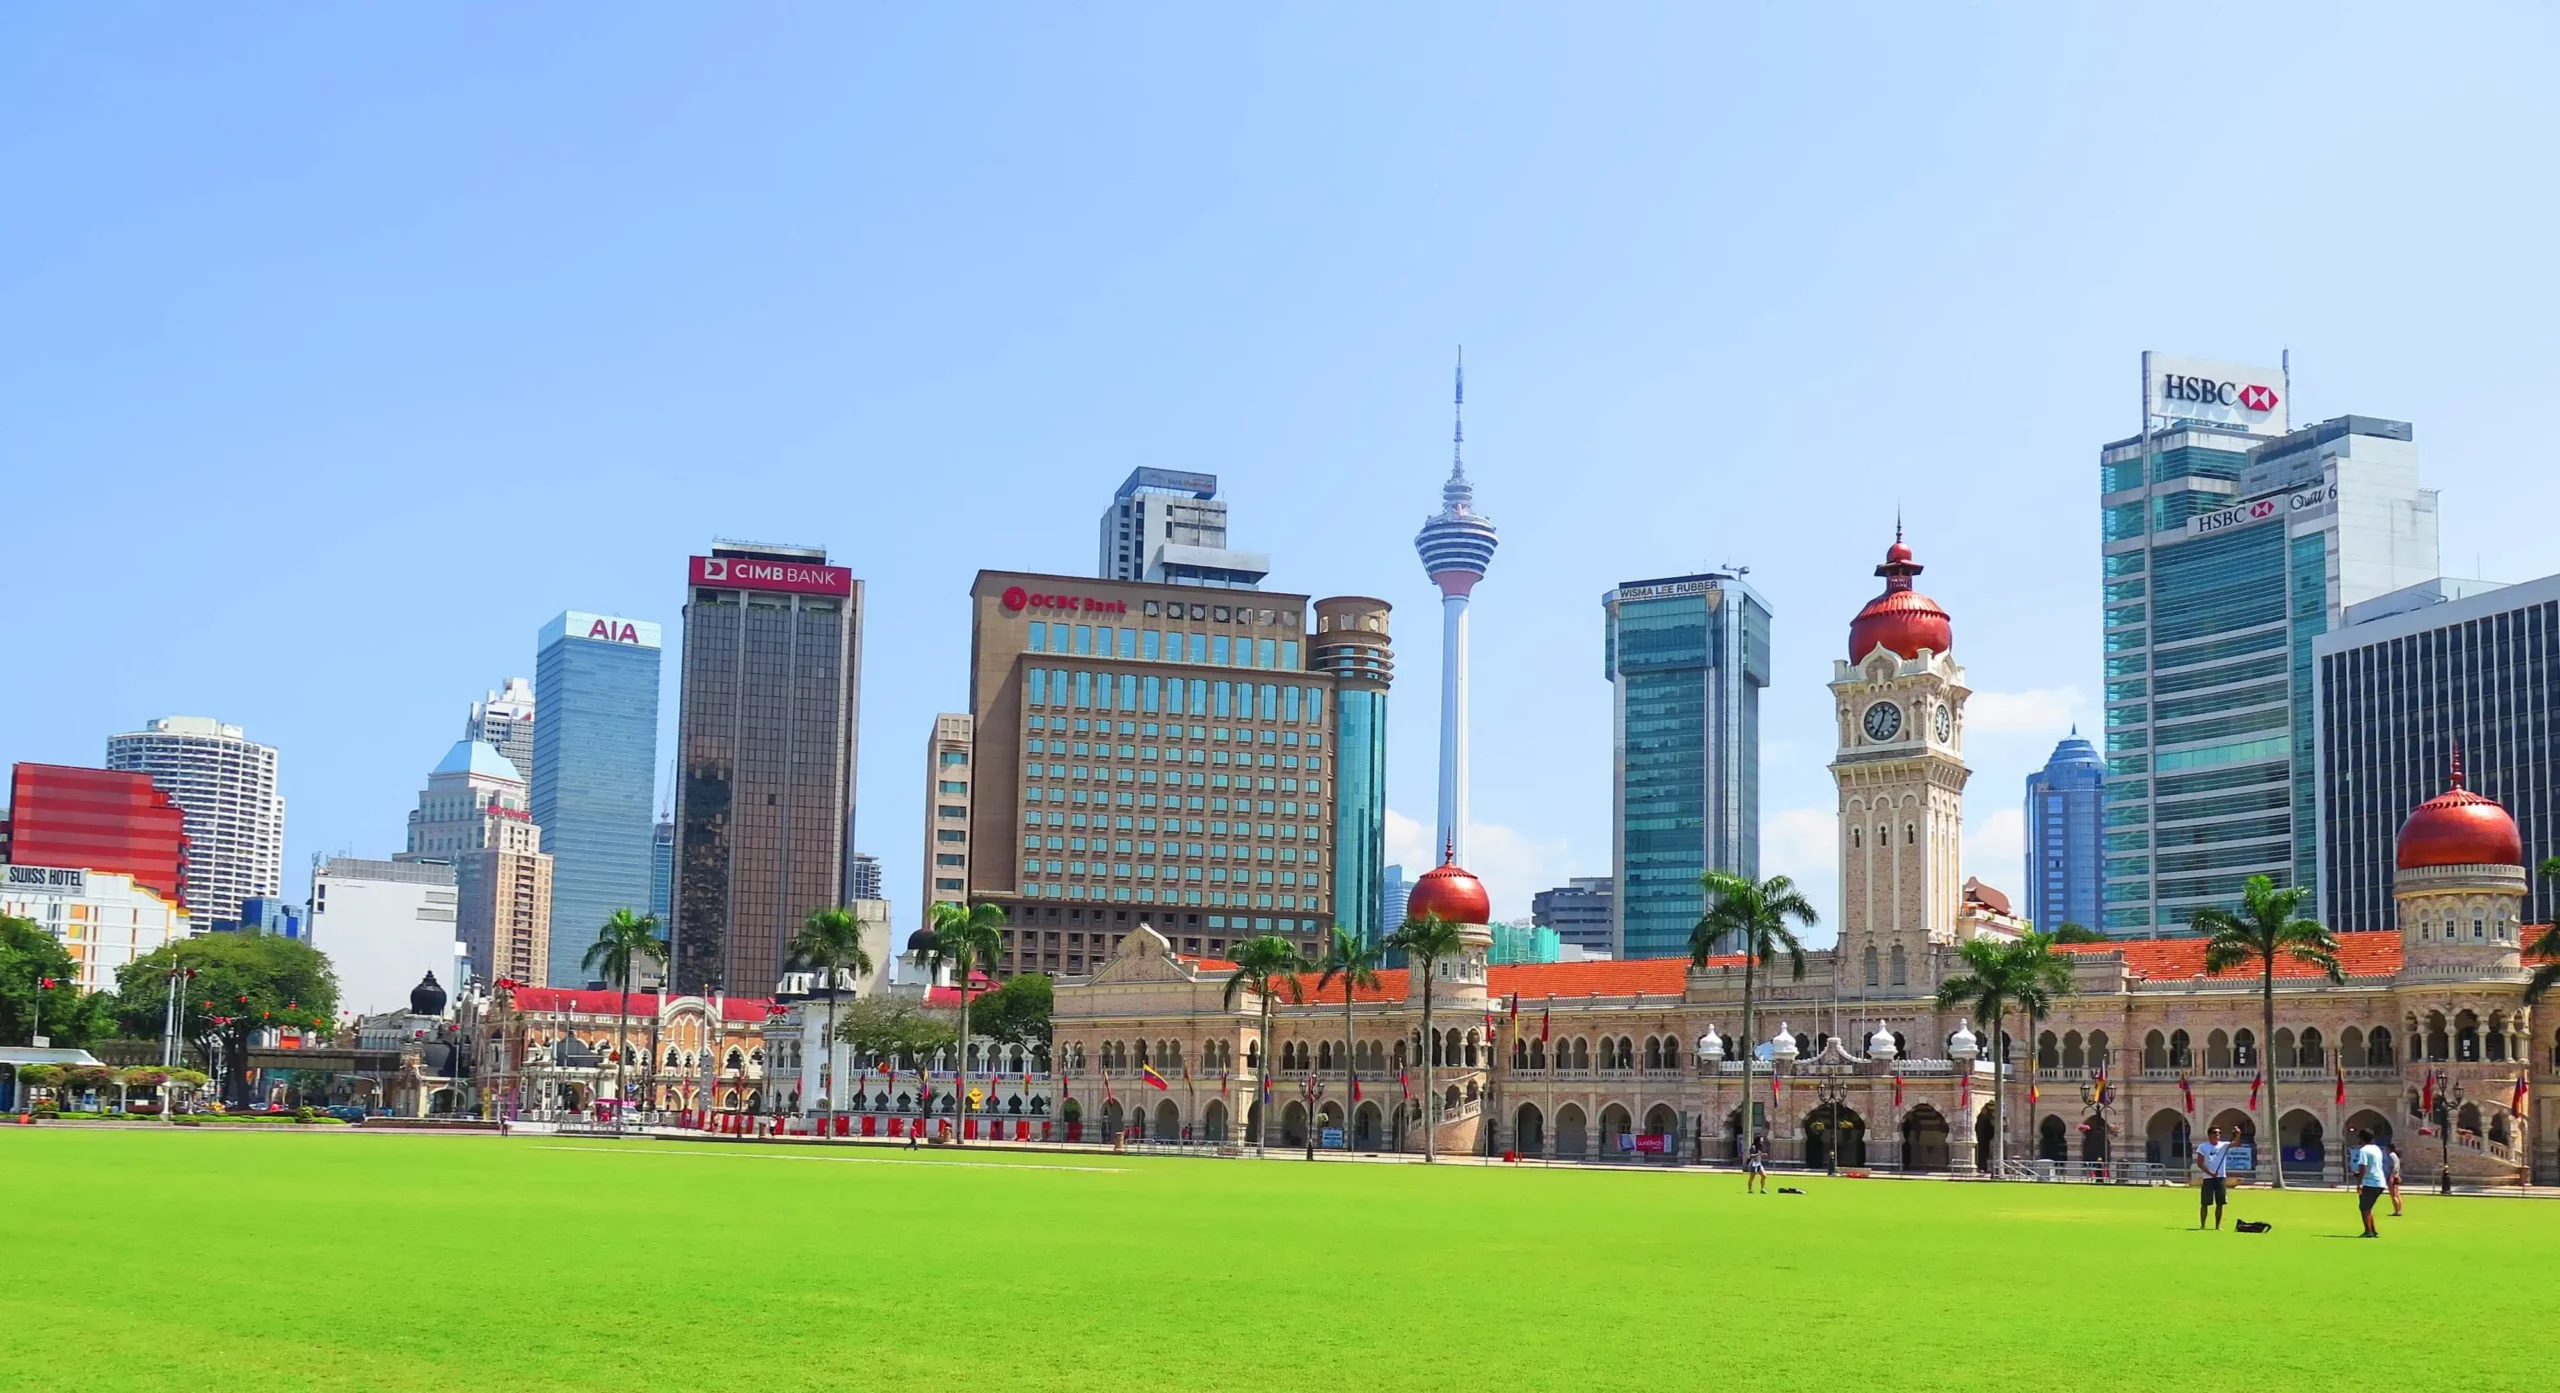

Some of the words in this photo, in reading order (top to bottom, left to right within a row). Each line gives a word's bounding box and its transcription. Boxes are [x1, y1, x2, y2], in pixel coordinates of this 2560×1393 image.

[2165, 374, 2237, 406] HSBC
[2328, 482, 2337, 500] 6
[2199, 507, 2246, 532] HSBC
[735, 564, 783, 581] CIMB
[787, 568, 836, 586] BANK
[1620, 587, 1653, 598] WISMA
[1656, 585, 1674, 595] LEE
[1676, 580, 1718, 593] RUBBER
[1029, 593, 1080, 611] OCBC
[1084, 597, 1127, 613] Bank
[588, 619, 639, 643] AIA
[9, 867, 46, 884] SWISS
[49, 869, 83, 886] HOTEL
